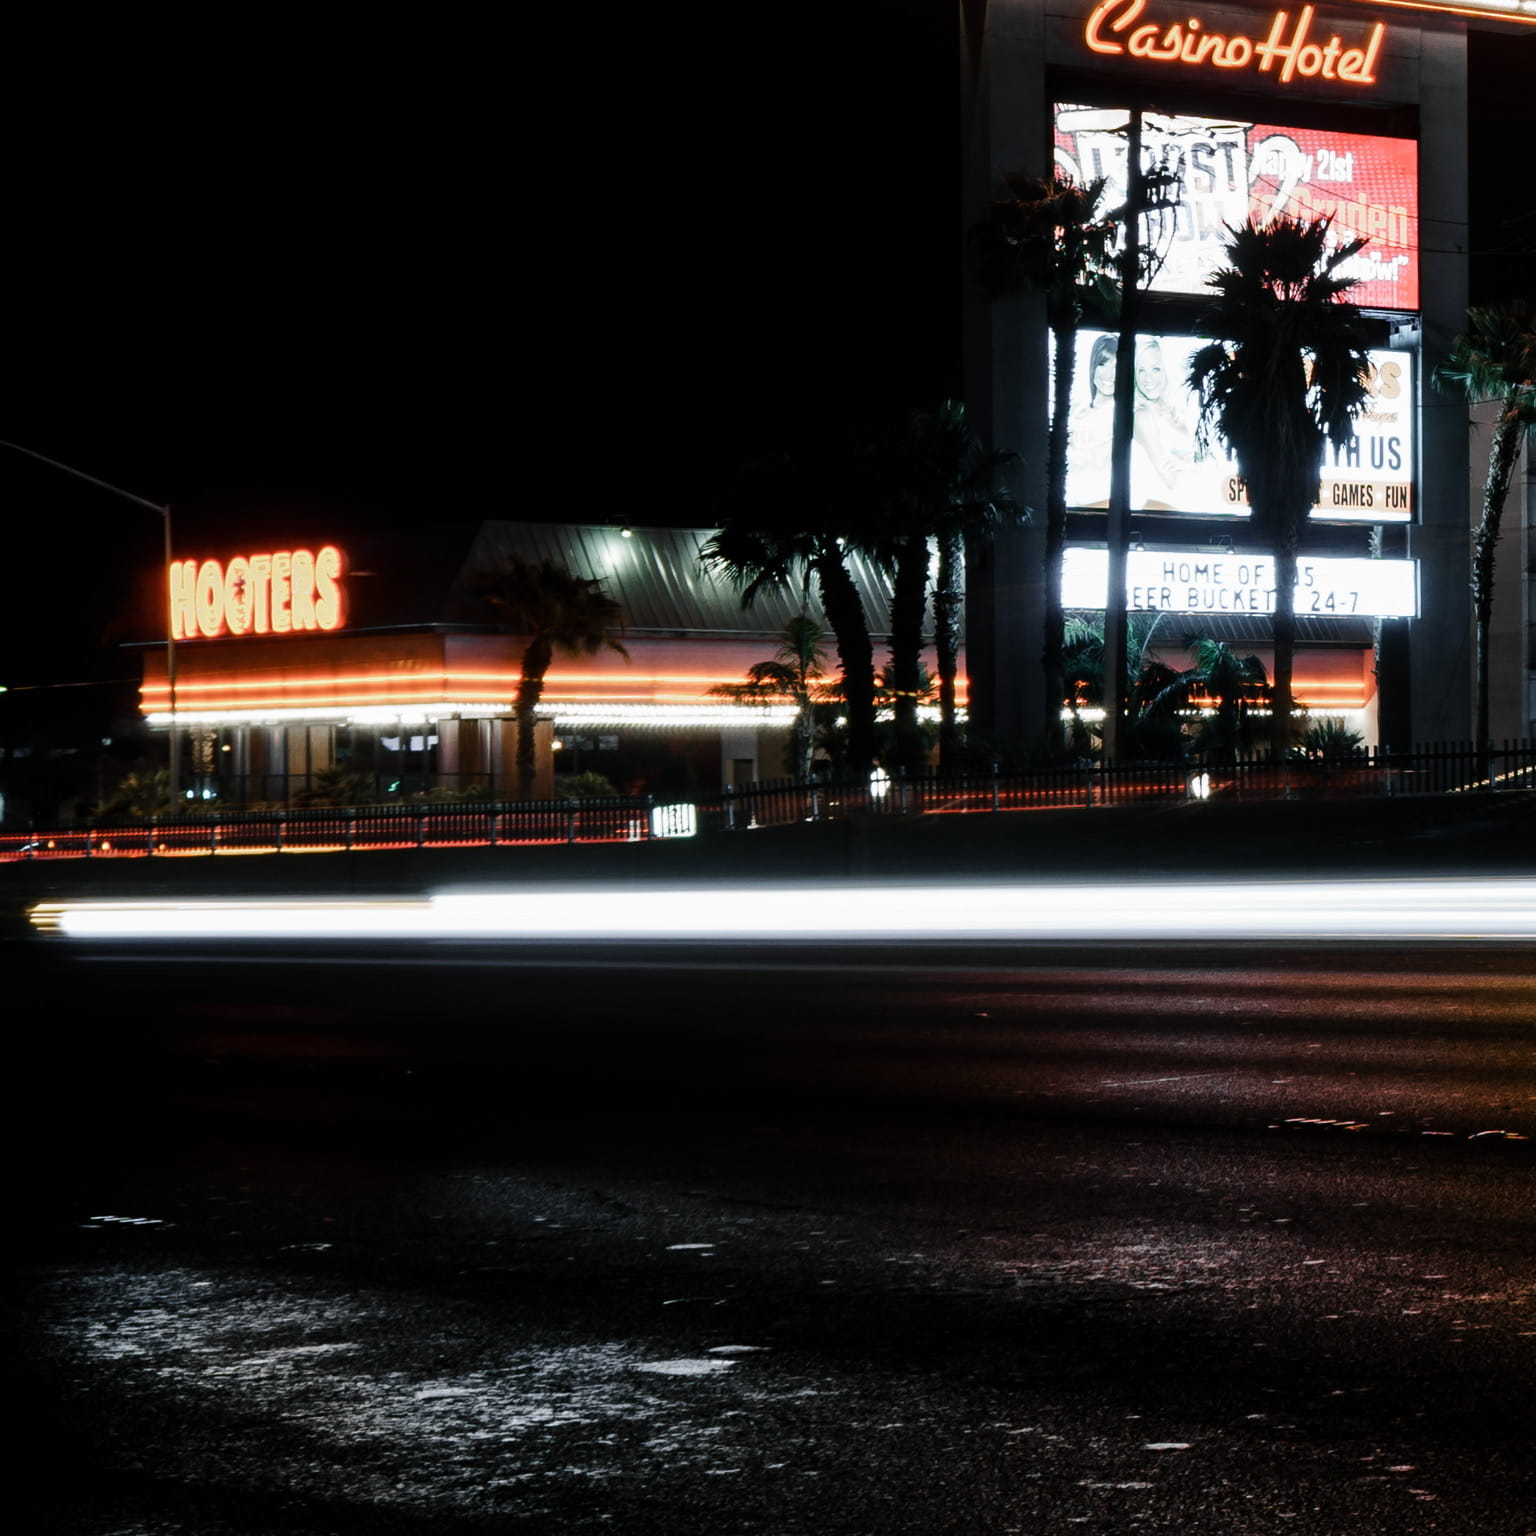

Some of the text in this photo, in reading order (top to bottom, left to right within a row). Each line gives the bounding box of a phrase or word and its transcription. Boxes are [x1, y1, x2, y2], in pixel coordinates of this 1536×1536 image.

[1255, 5, 1386, 83] Hotel
[1317, 149, 1355, 183] 21st
[1371, 436, 1402, 471] US
[1332, 483, 1408, 509] GAMES FUN
[1163, 562, 1224, 584] HOME
[1238, 565, 1265, 586] OF
[169, 545, 341, 641] HOOTERS
[1122, 586, 1359, 613] EER BUCKET 24-7
